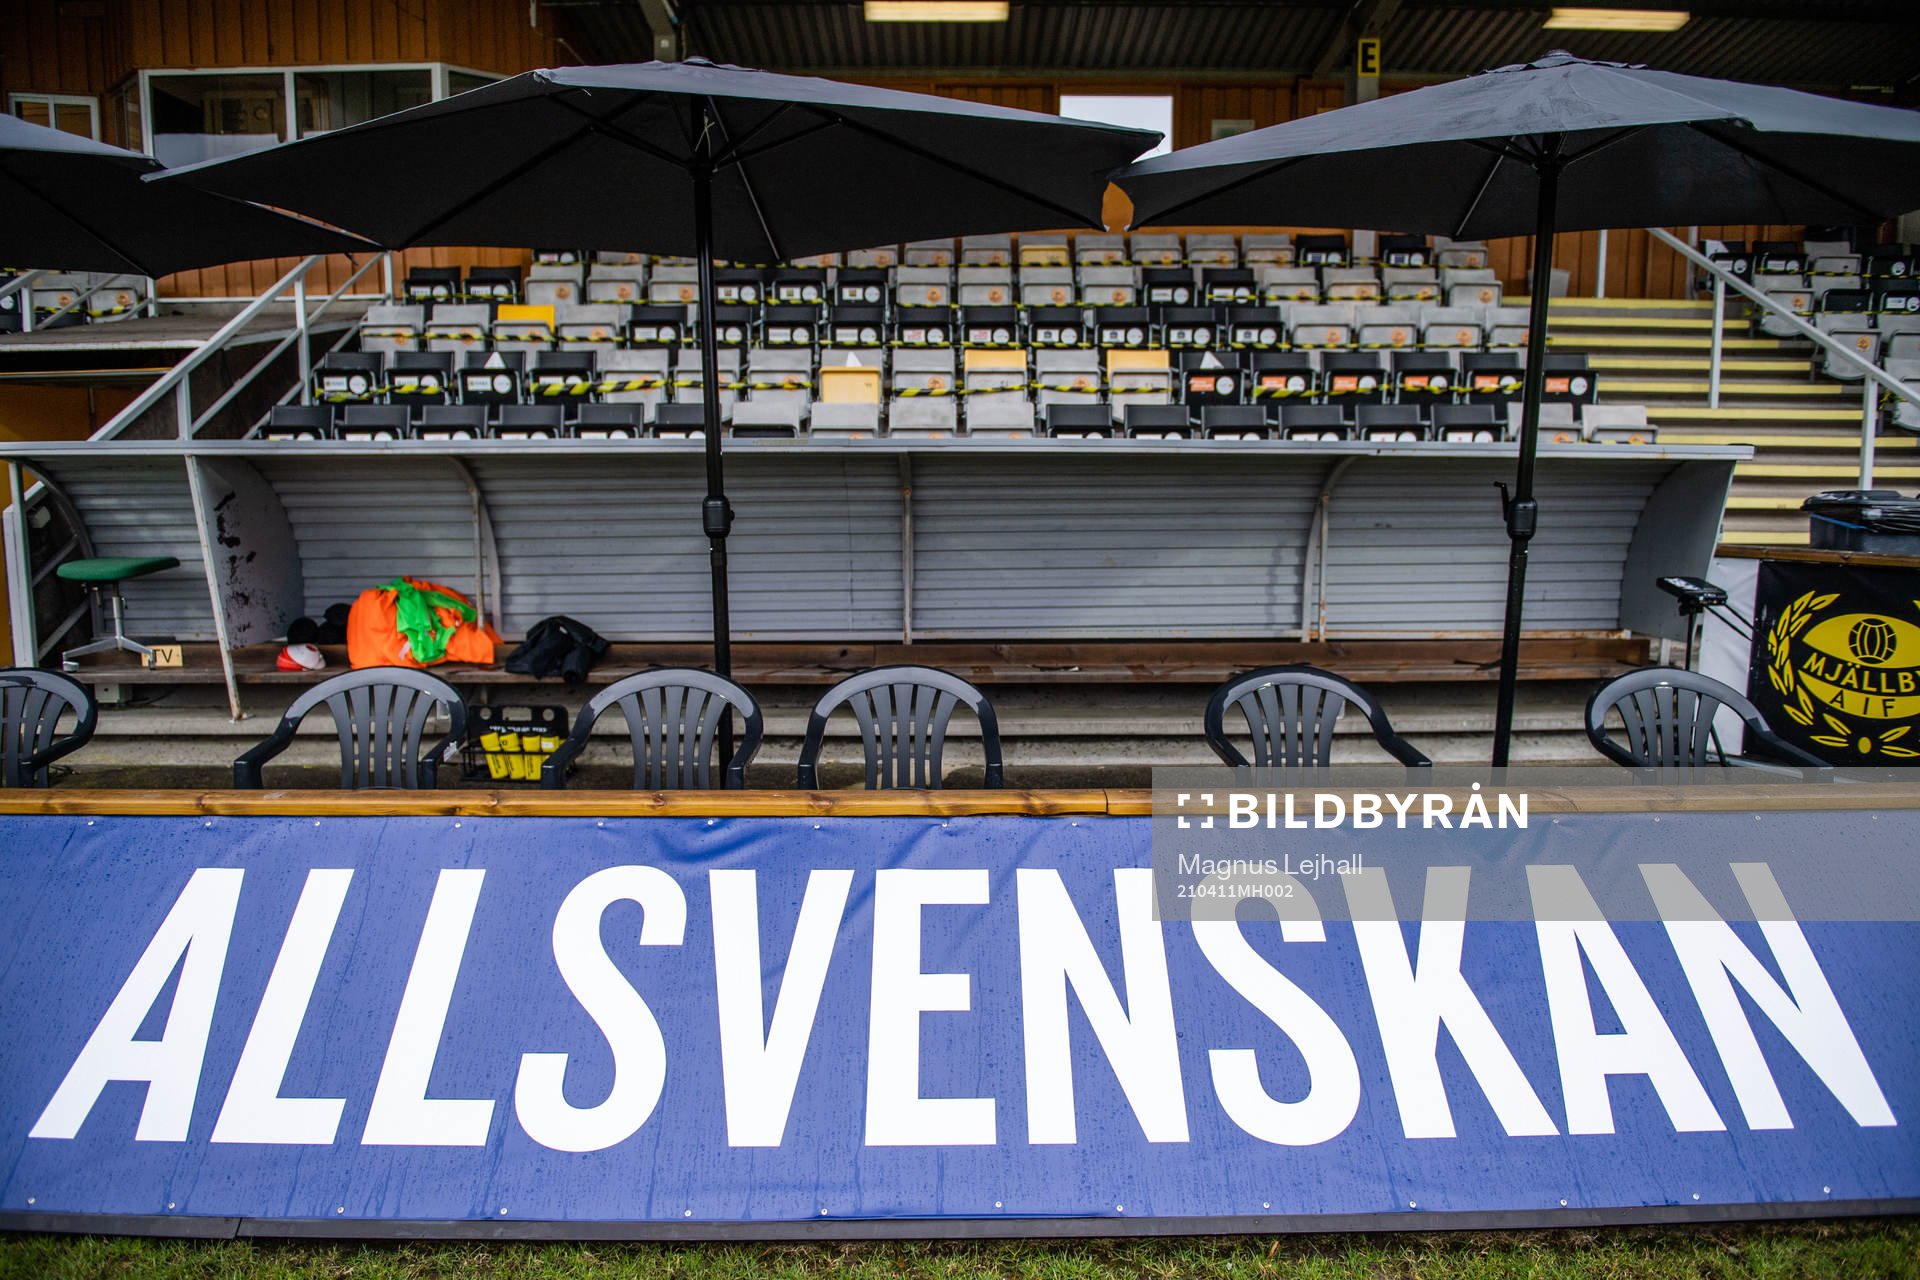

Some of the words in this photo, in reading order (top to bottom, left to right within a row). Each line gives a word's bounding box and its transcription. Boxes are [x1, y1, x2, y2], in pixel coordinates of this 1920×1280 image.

[1361, 42, 1376, 73] E
[152, 648, 173, 663] TV
[1803, 652, 1920, 694] MJÄLLB
[28, 863, 1898, 1154] ALLSVENSKAN
